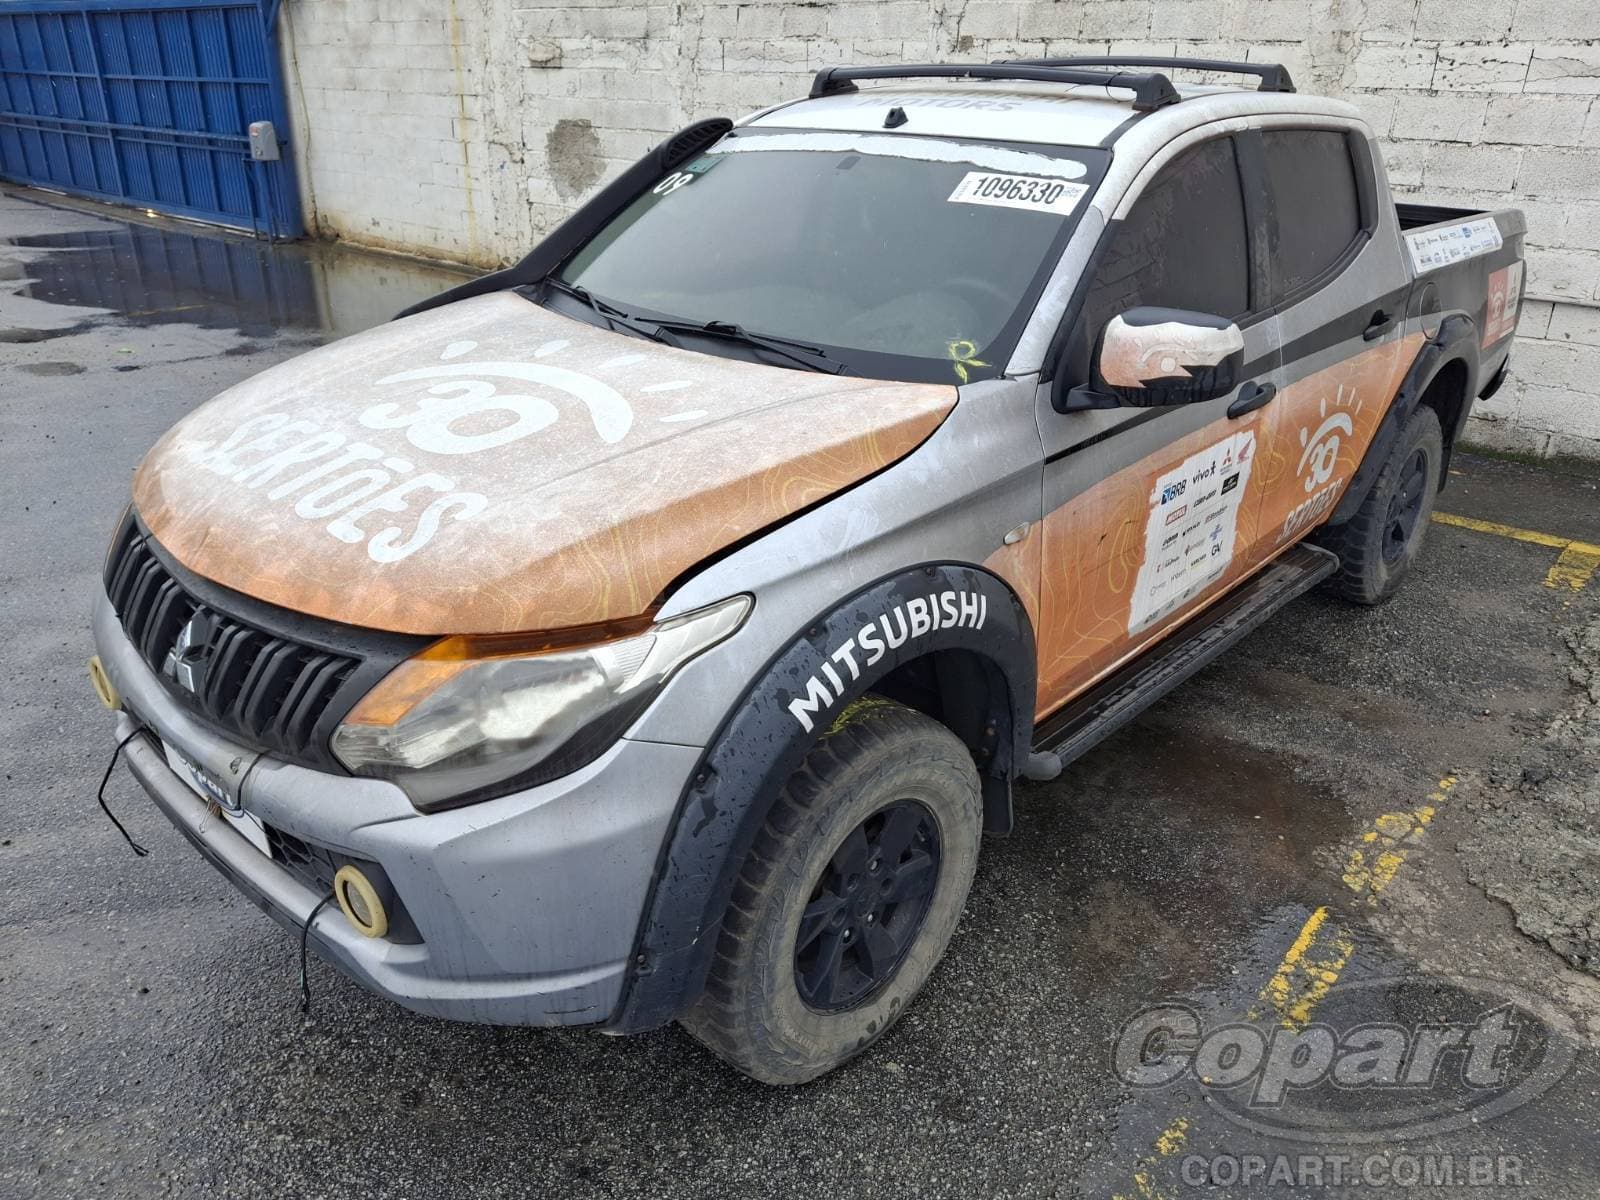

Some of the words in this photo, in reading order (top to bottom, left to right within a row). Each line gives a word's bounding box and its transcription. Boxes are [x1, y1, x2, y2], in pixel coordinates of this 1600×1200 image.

[857, 97, 1023, 112] MOTORS
[973, 176, 1064, 205] 1096330
[358, 380, 560, 455] 30
[1193, 468, 1210, 485] vivo
[1304, 435, 1340, 493] 30
[1169, 479, 1187, 501] BRB
[787, 590, 987, 734] MITSUBISHI
